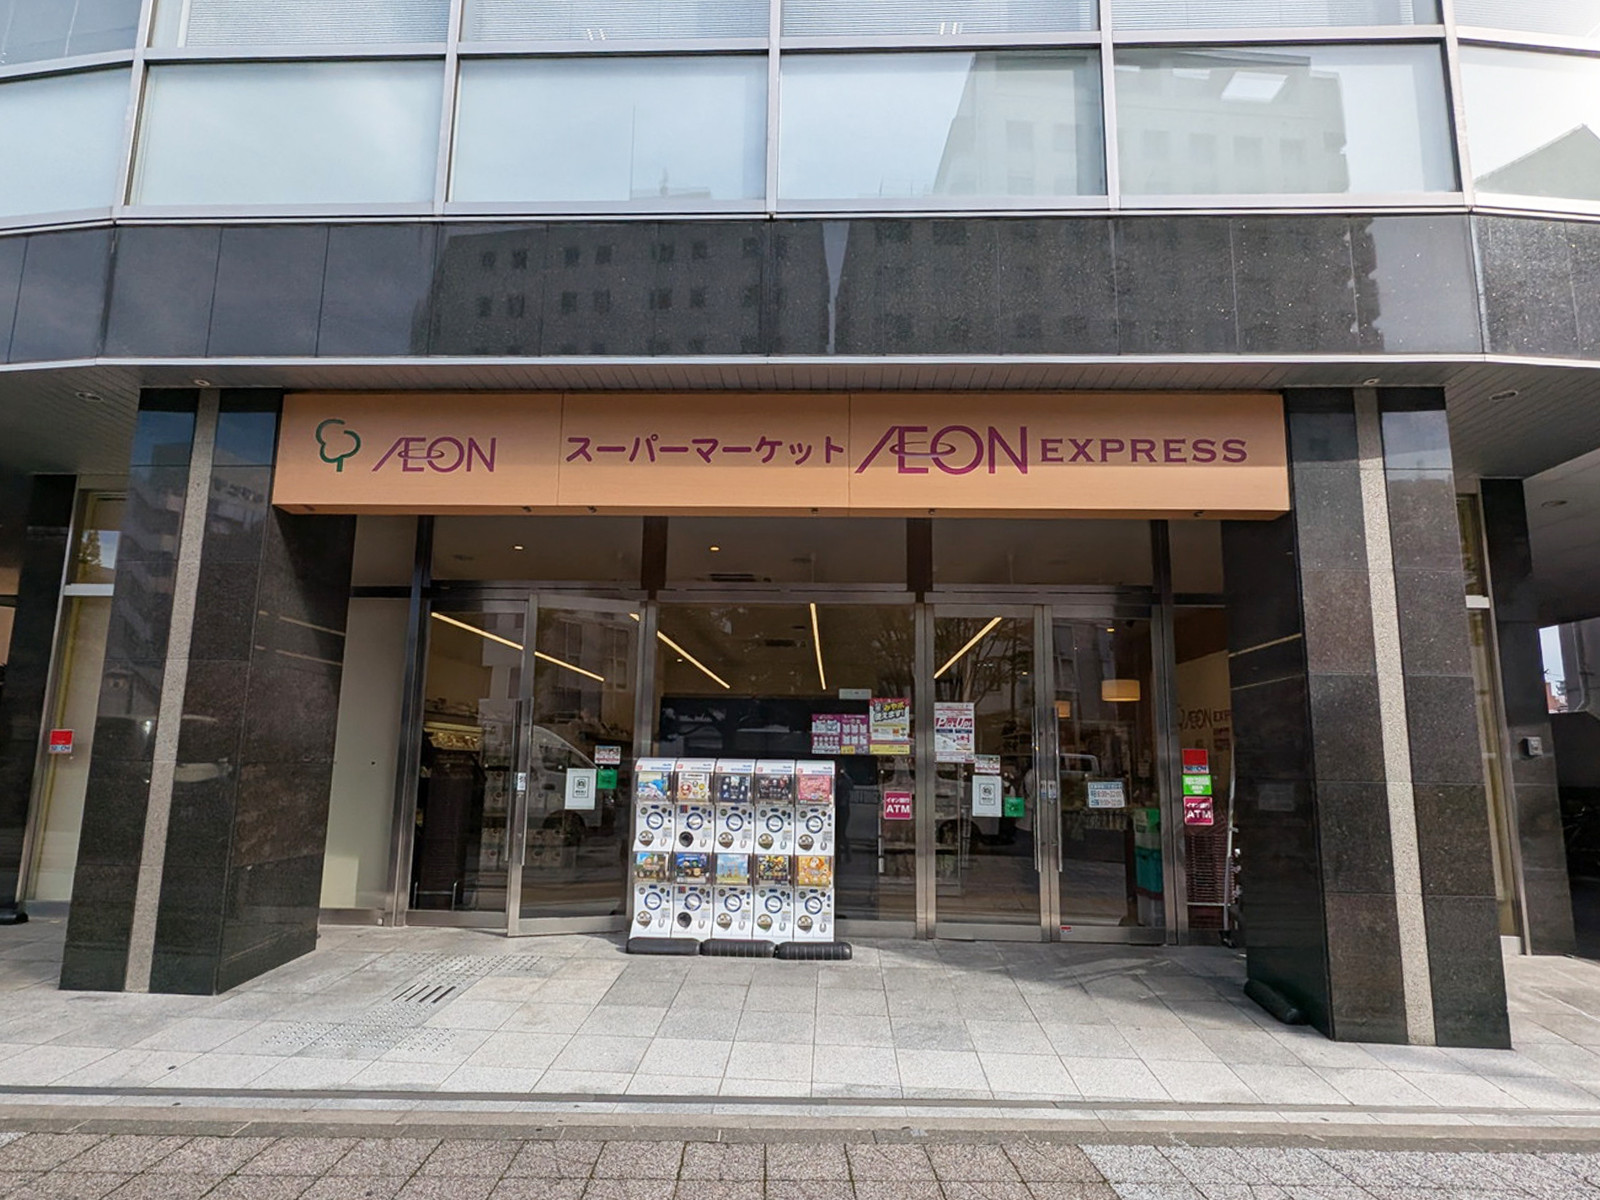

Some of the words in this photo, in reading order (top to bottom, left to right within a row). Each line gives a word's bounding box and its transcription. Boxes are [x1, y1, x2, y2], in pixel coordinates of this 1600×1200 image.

[565, 433, 844, 466] スーパーマーケット
[1040, 437, 1248, 464] EXPRESS
[886, 804, 910, 813] ATM
[1187, 809, 1211, 819] ATM
